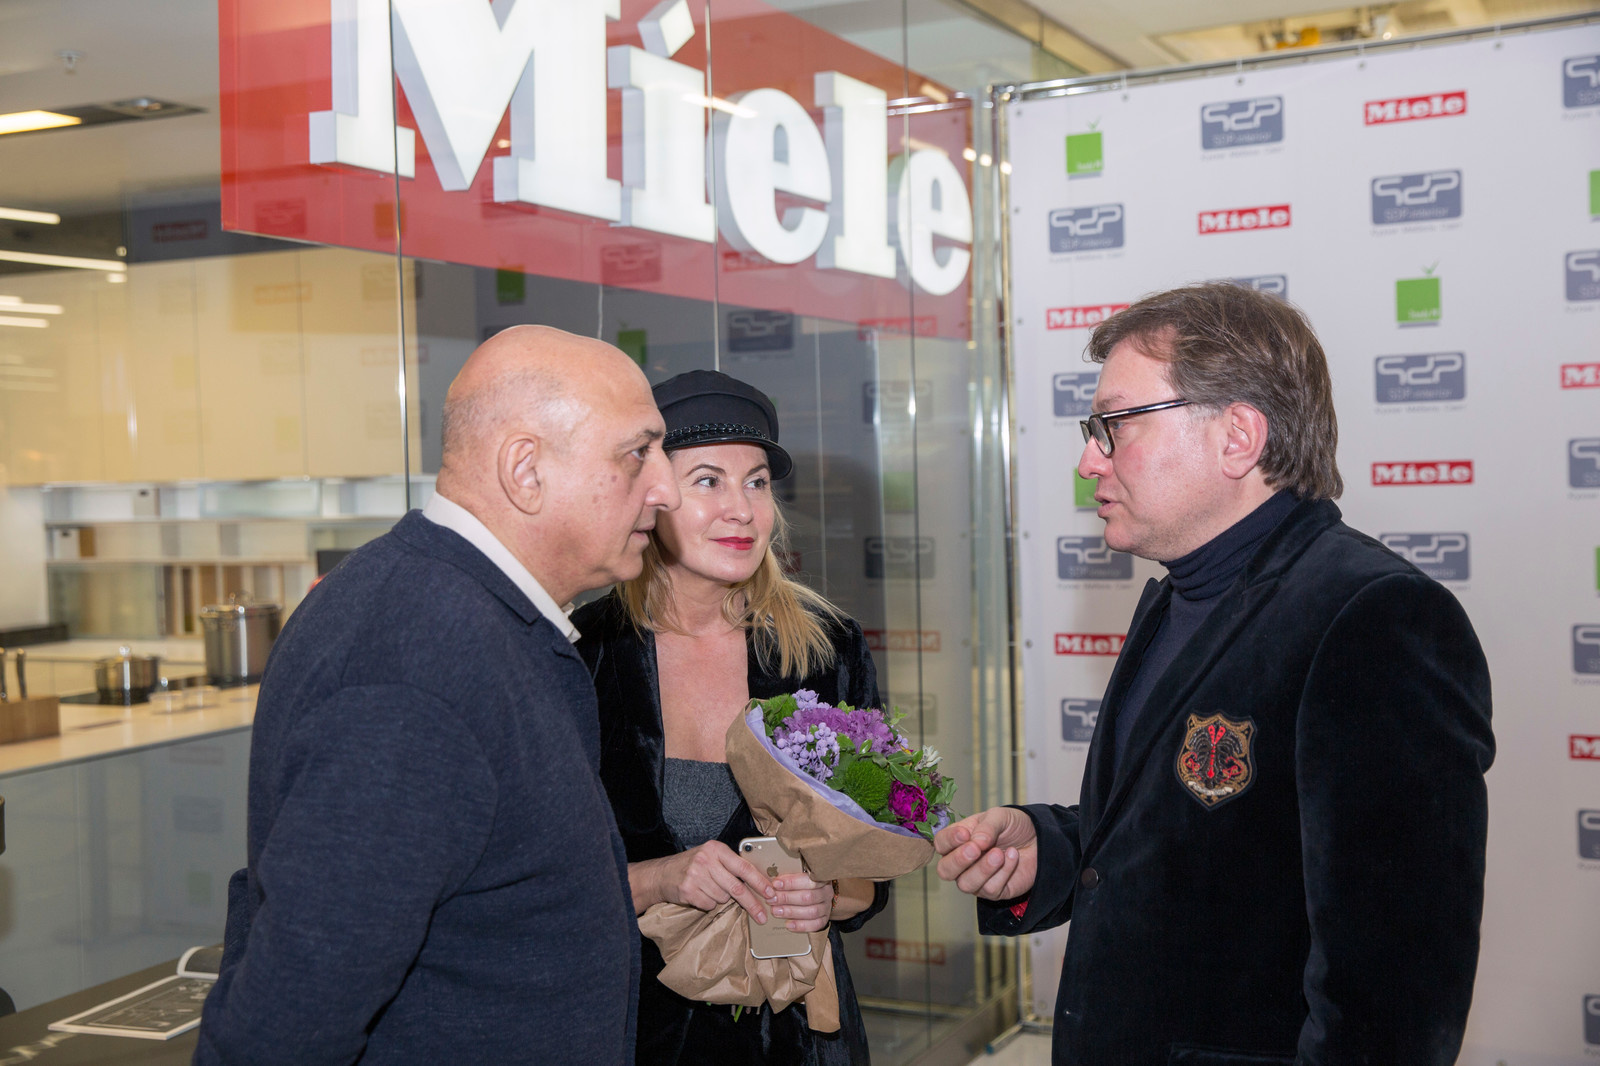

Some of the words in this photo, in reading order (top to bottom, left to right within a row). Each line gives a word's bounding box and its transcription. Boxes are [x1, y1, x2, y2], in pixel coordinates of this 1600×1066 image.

[1367, 95, 1464, 122] Miele
[308, 0, 973, 297] Miele
[1201, 208, 1289, 232] Miele
[1048, 308, 1121, 328] Miel
[1373, 463, 1471, 483] Miele
[1058, 636, 1125, 653] Miel
